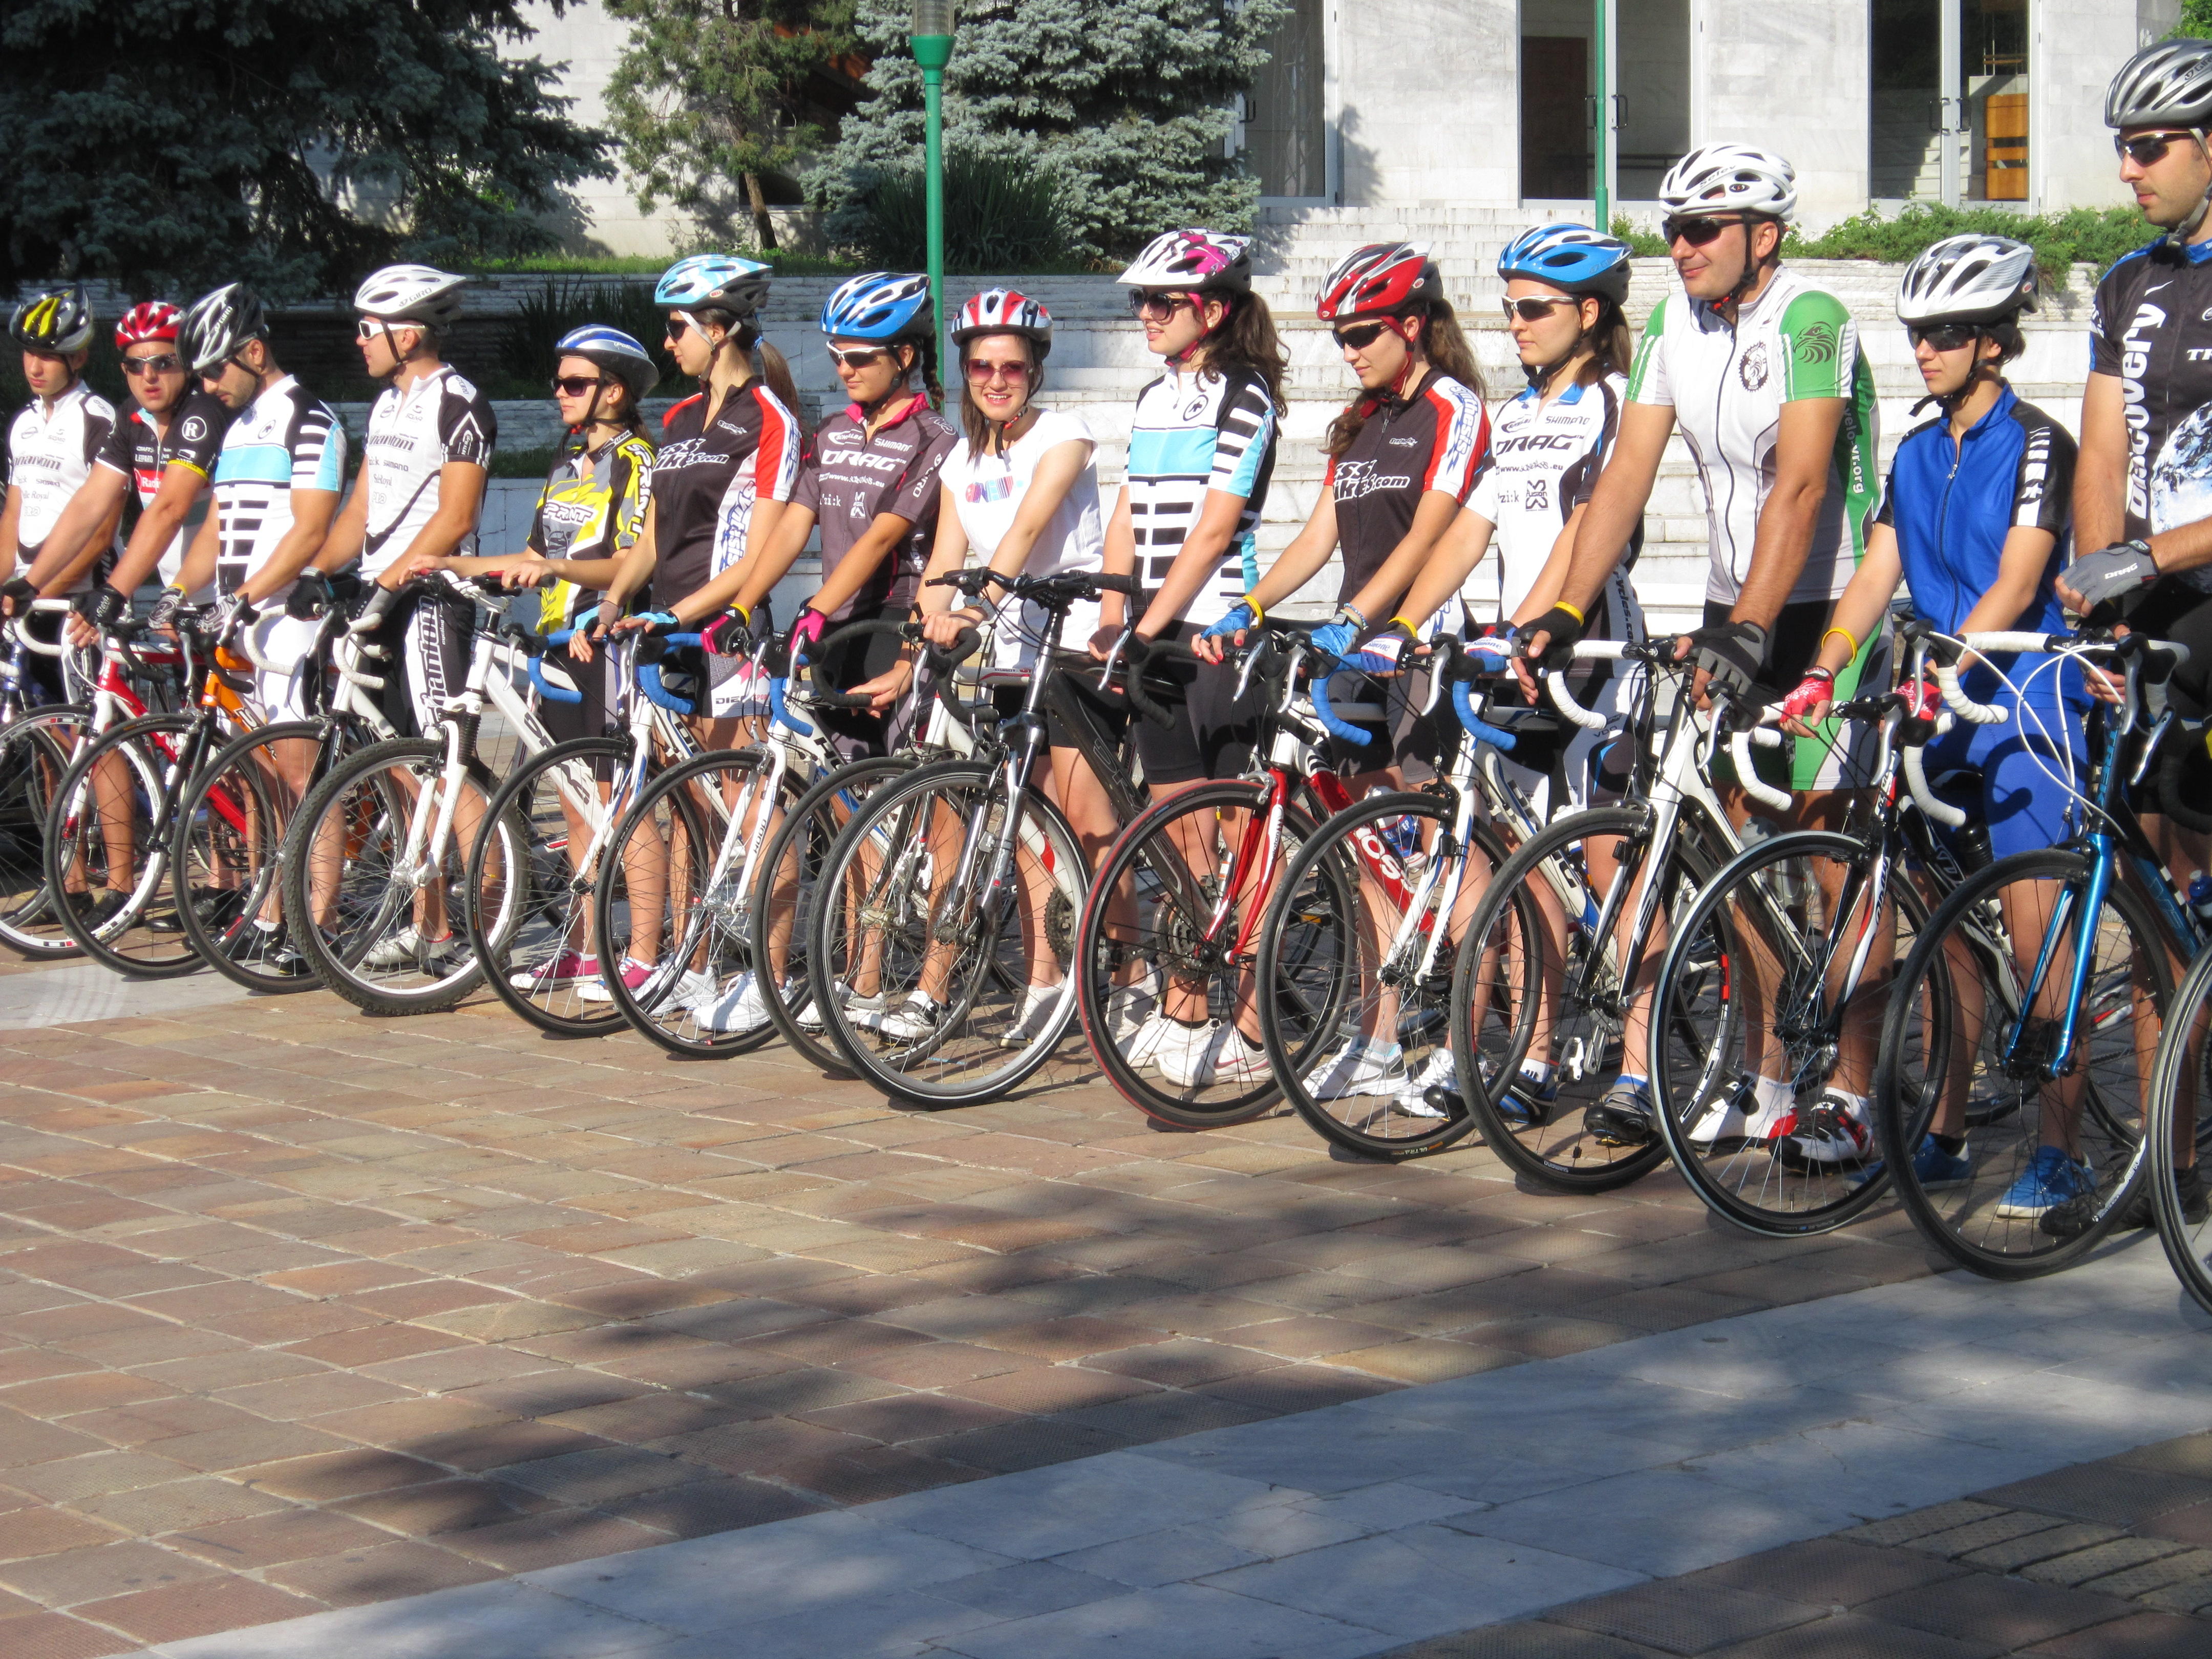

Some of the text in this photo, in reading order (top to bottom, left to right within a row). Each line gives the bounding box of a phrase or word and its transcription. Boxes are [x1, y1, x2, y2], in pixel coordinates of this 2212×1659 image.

[409, 287, 433, 302] GIRO
[821, 450, 897, 471] DRAG
[2104, 563, 2138, 580] DRAG
